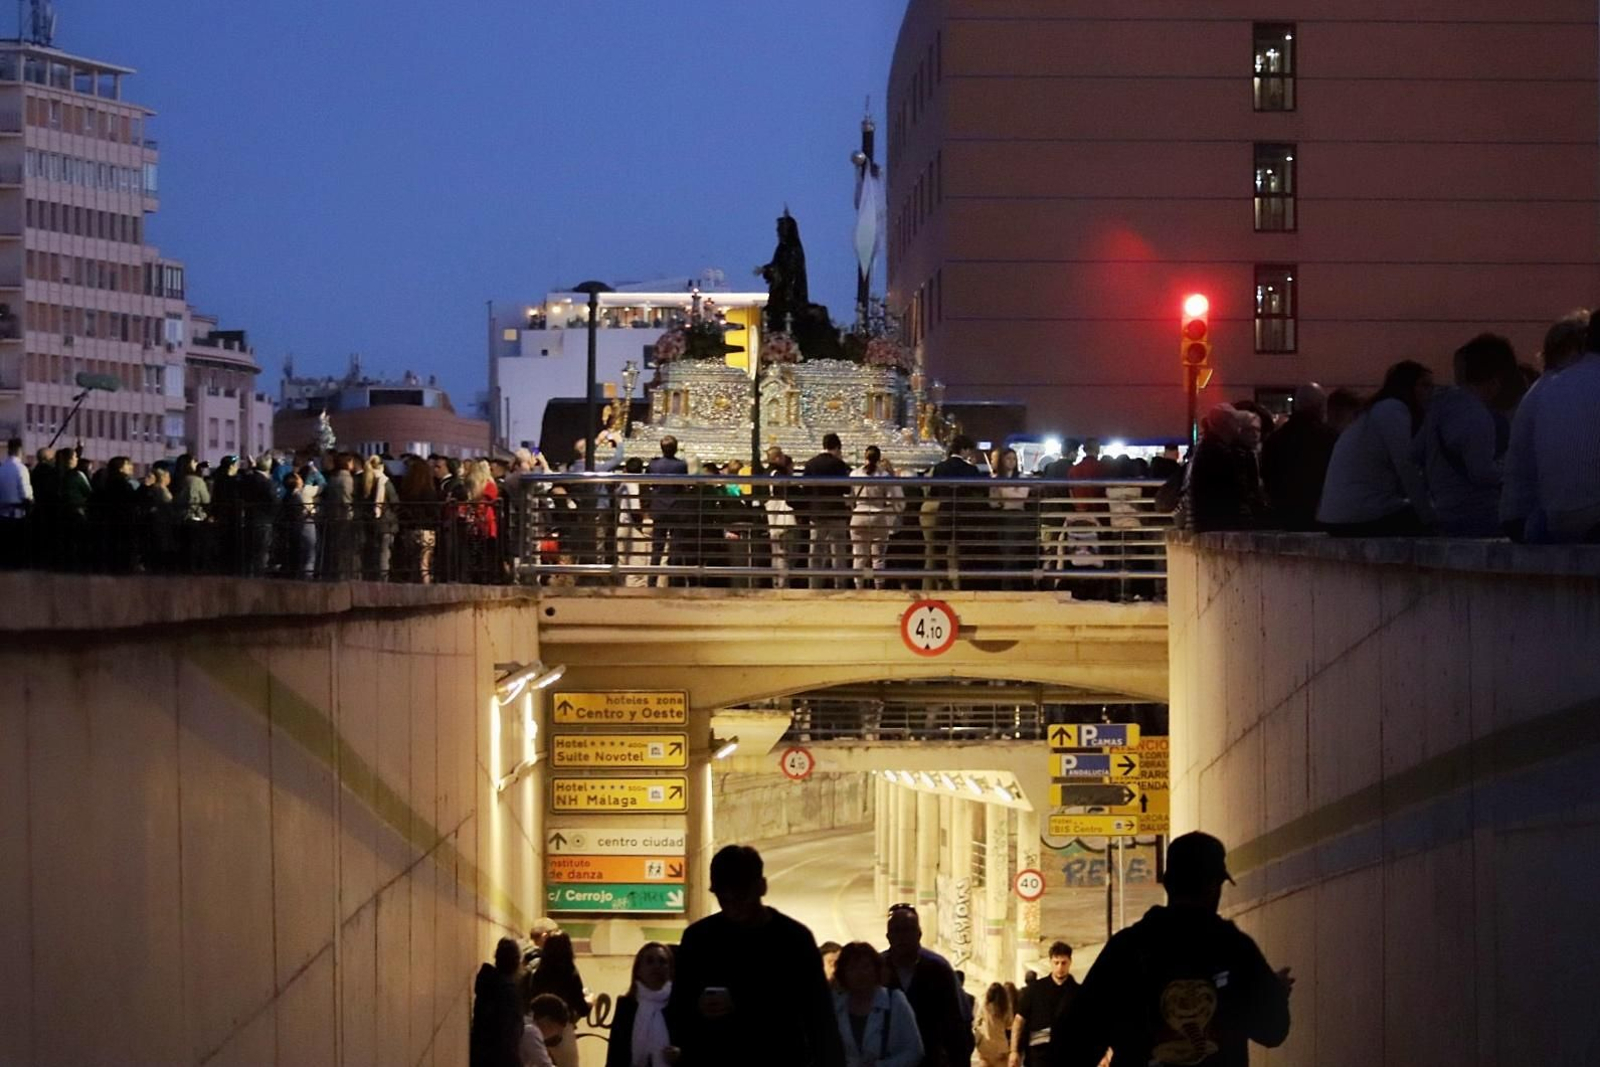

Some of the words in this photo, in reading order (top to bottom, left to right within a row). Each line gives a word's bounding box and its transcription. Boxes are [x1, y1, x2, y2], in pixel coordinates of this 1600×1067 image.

[606, 696, 649, 705] hoteles
[656, 697, 683, 705] zona
[576, 707, 623, 719] Centro
[629, 710, 637, 721] y
[642, 708, 683, 718] Oeste
[1082, 726, 1098, 746] P
[1091, 738, 1123, 746] CAMAS
[556, 740, 587, 748] Hotel
[557, 752, 589, 762] Suite
[595, 751, 644, 761] Novotel
[1062, 755, 1077, 776] P
[556, 784, 587, 792] Hotel
[556, 795, 578, 806] NH
[598, 837, 638, 847] centro
[642, 836, 684, 847] ciudad
[550, 857, 590, 867] nstituto
[567, 869, 603, 879] danza
[1020, 877, 1039, 889] 40
[548, 890, 561, 901] c/
[565, 890, 613, 903] Cerrojo
